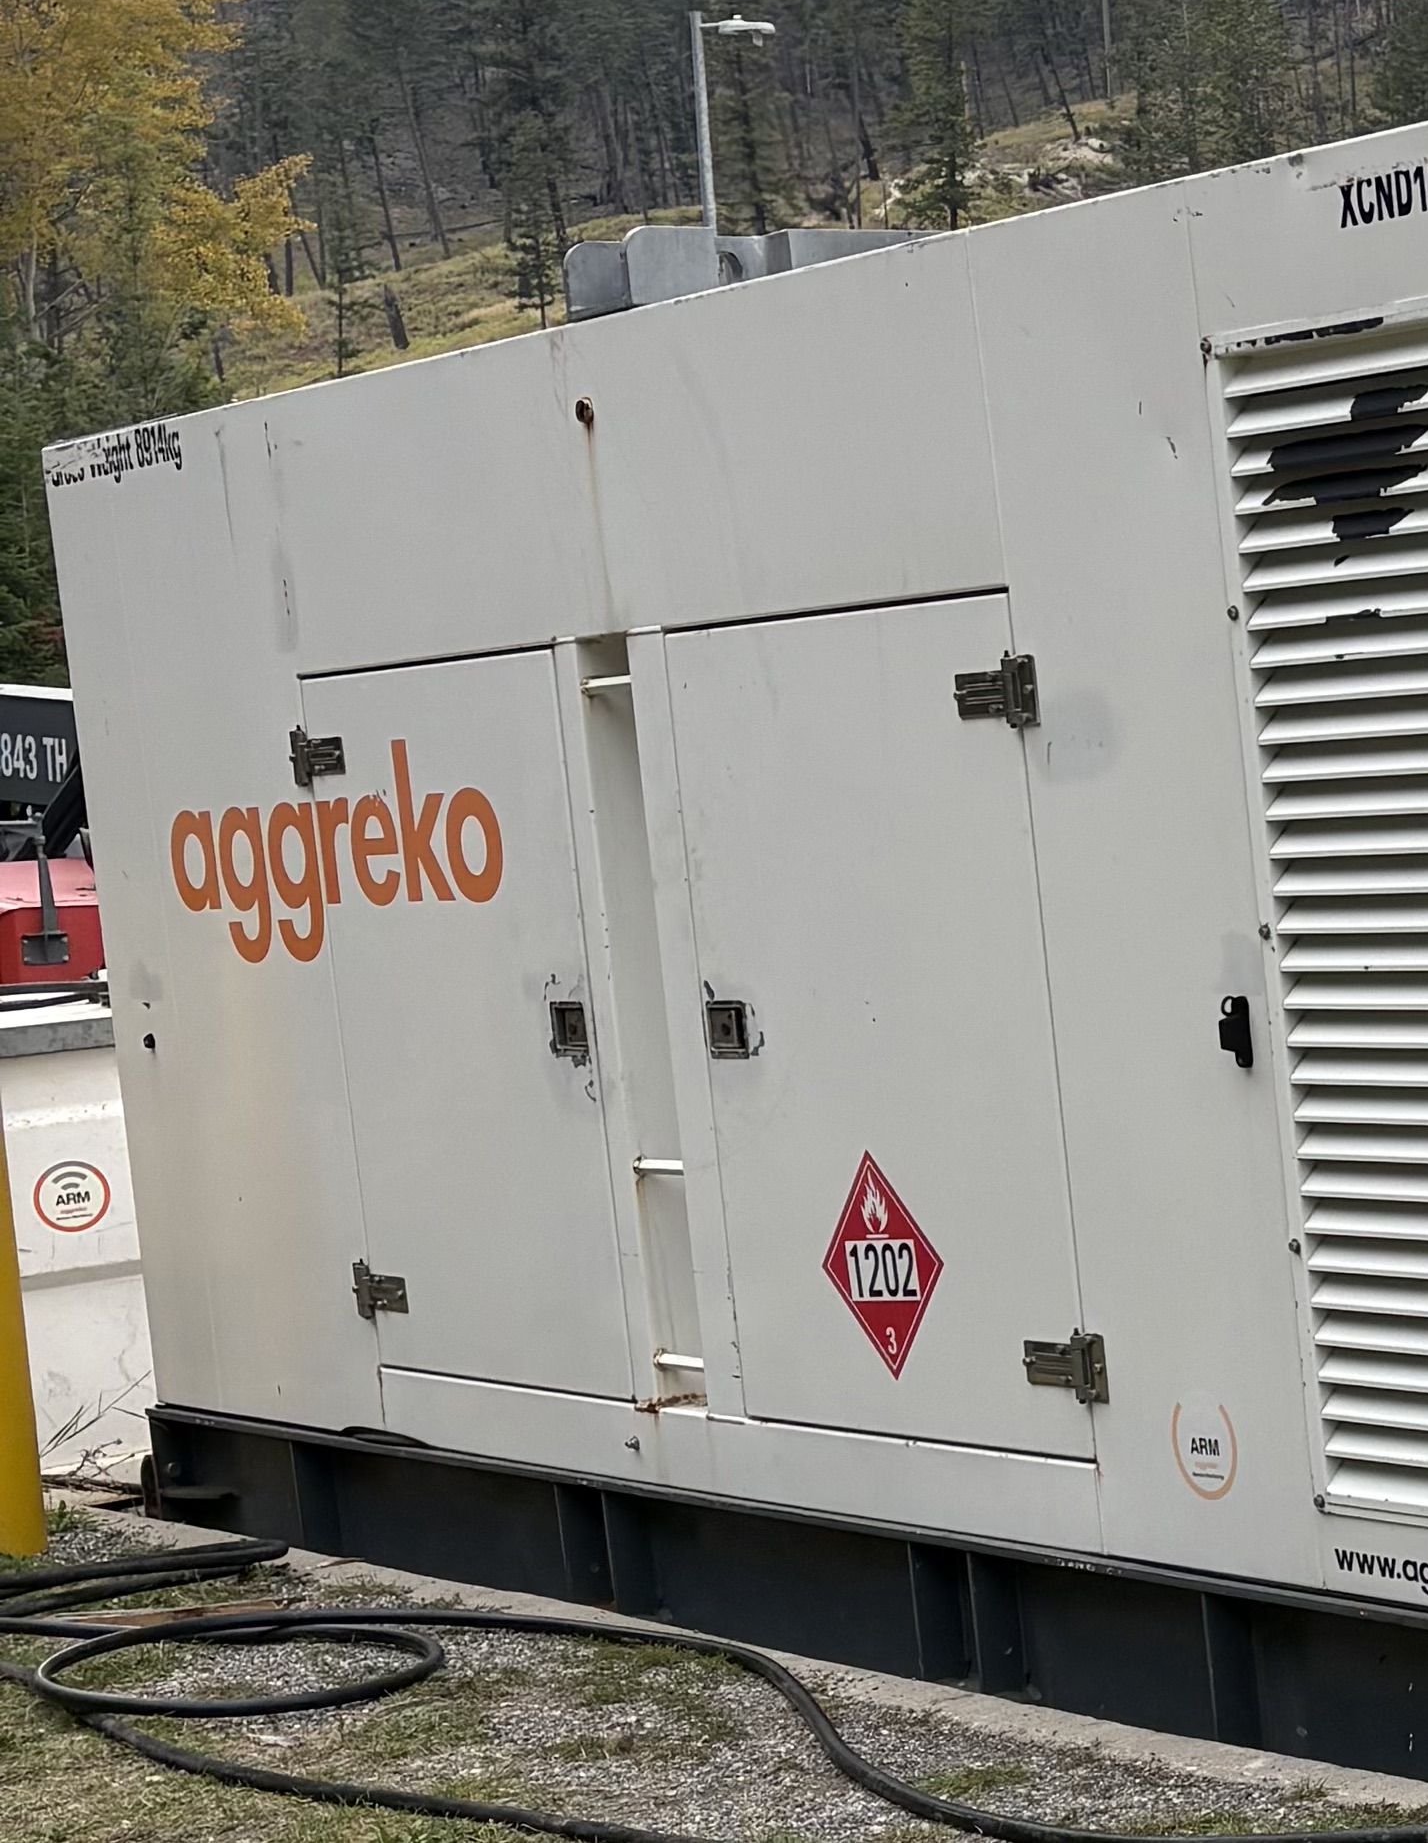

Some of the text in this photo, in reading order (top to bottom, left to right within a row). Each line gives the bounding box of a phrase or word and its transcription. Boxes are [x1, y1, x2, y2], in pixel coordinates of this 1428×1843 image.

[171, 739, 503, 963] aggreko
[55, 1190, 91, 1207] ARM
[848, 1242, 918, 1298] 1202
[885, 1326, 898, 1355] 3
[1190, 1437, 1220, 1456] ARM
